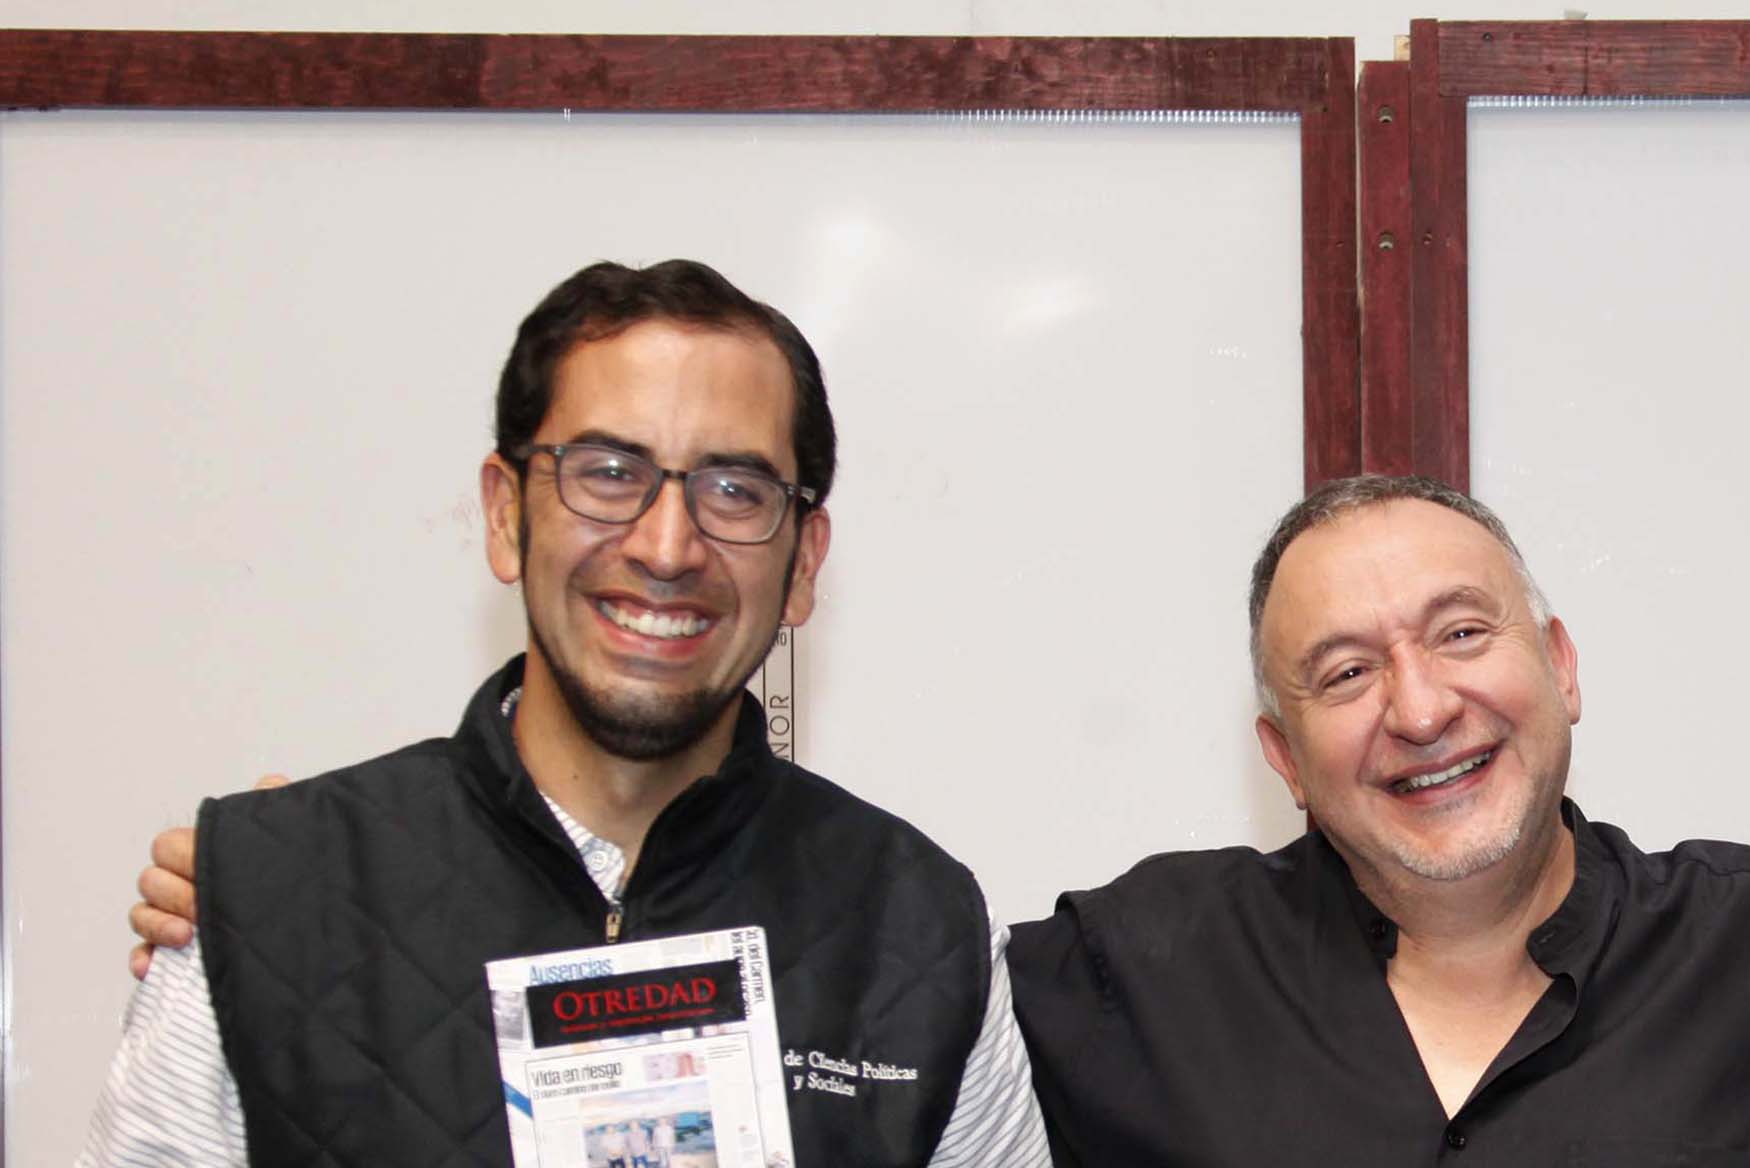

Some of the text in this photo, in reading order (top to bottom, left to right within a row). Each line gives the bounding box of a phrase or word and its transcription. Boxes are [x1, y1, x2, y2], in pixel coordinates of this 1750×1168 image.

[784, 1049, 804, 1066] de
[808, 1051, 858, 1077] Ciencias
[793, 1071, 856, 1097] y Sociales
